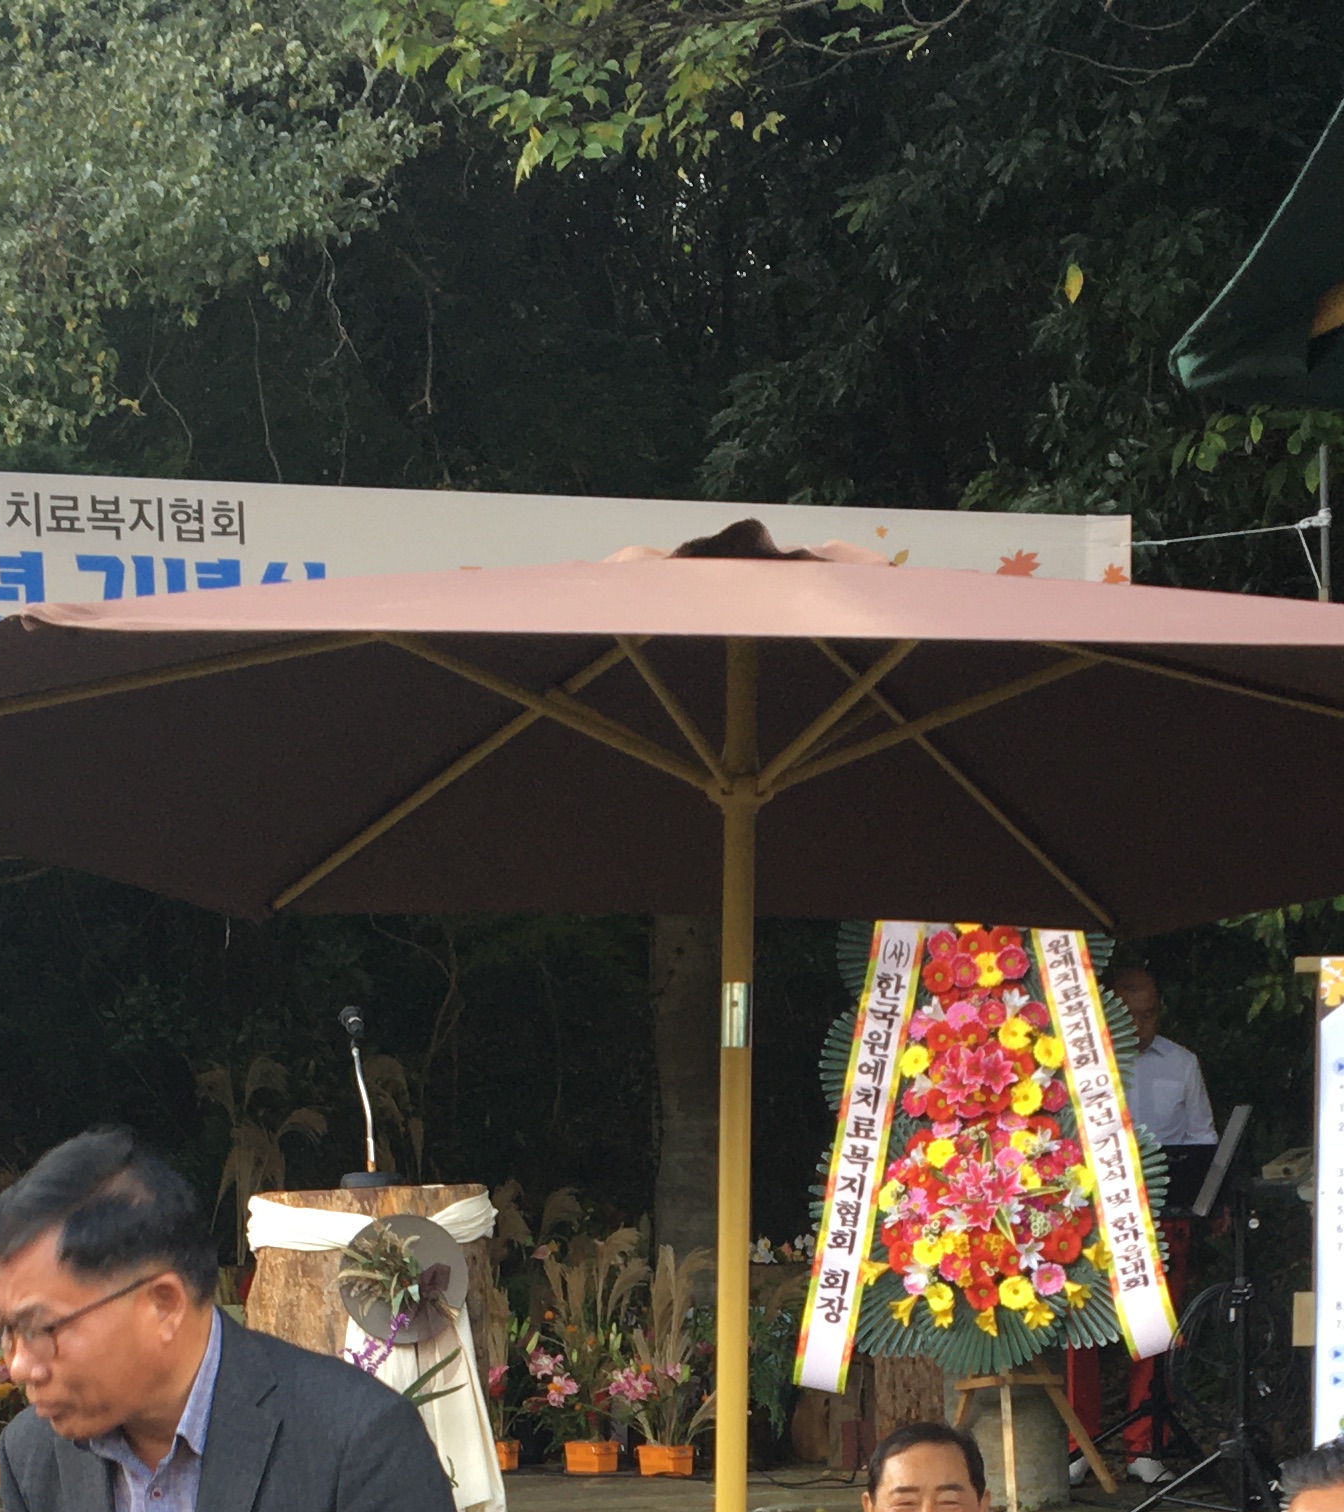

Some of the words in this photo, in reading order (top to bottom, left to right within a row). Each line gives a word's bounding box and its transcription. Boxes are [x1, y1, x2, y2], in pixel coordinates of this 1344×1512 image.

[1046, 934, 1099, 1070] 원예치료복지협회
[827, 939, 911, 1256] (사)한국원예치료복지협회
[1079, 1073, 1116, 1127] 20주년
[1093, 1132, 1127, 1181] 기념식
[1105, 1188, 1132, 1209] 및
[1110, 1212, 1149, 1291] 한마음대회
[816, 1269, 850, 1323] 회장
